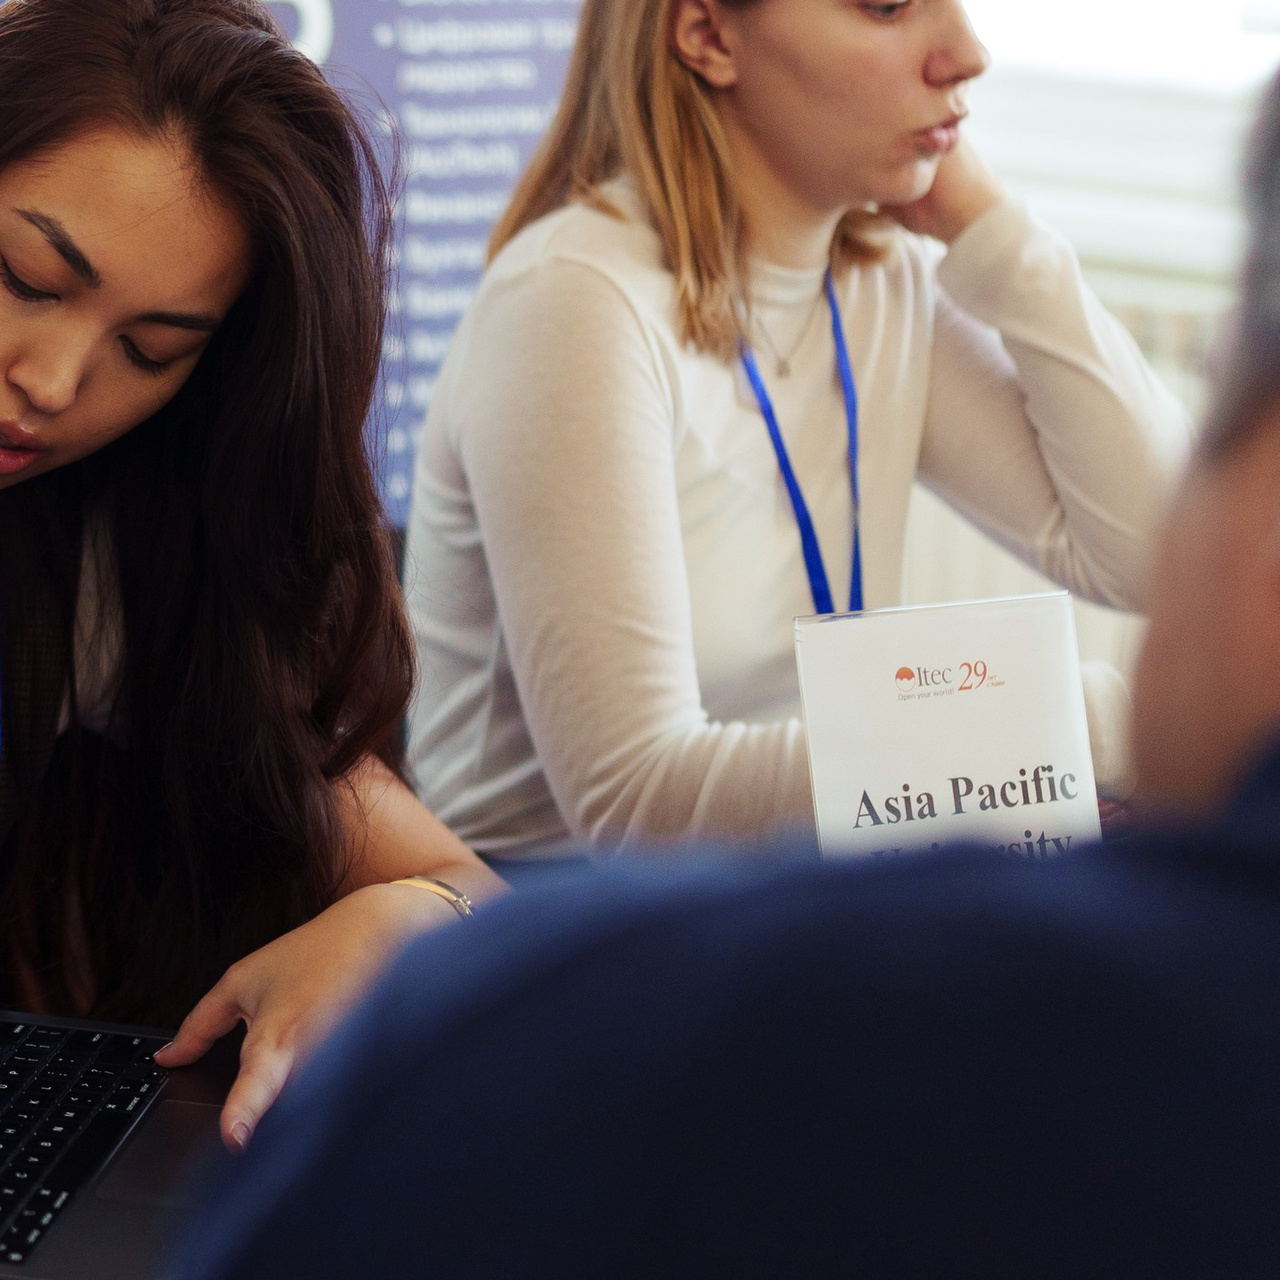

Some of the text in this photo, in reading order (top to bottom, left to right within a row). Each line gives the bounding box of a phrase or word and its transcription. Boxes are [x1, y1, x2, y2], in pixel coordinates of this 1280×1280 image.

[916, 660, 988, 691] Itec 29
[898, 688, 955, 702] Open your world!
[853, 764, 1079, 829] Asia Pacific
